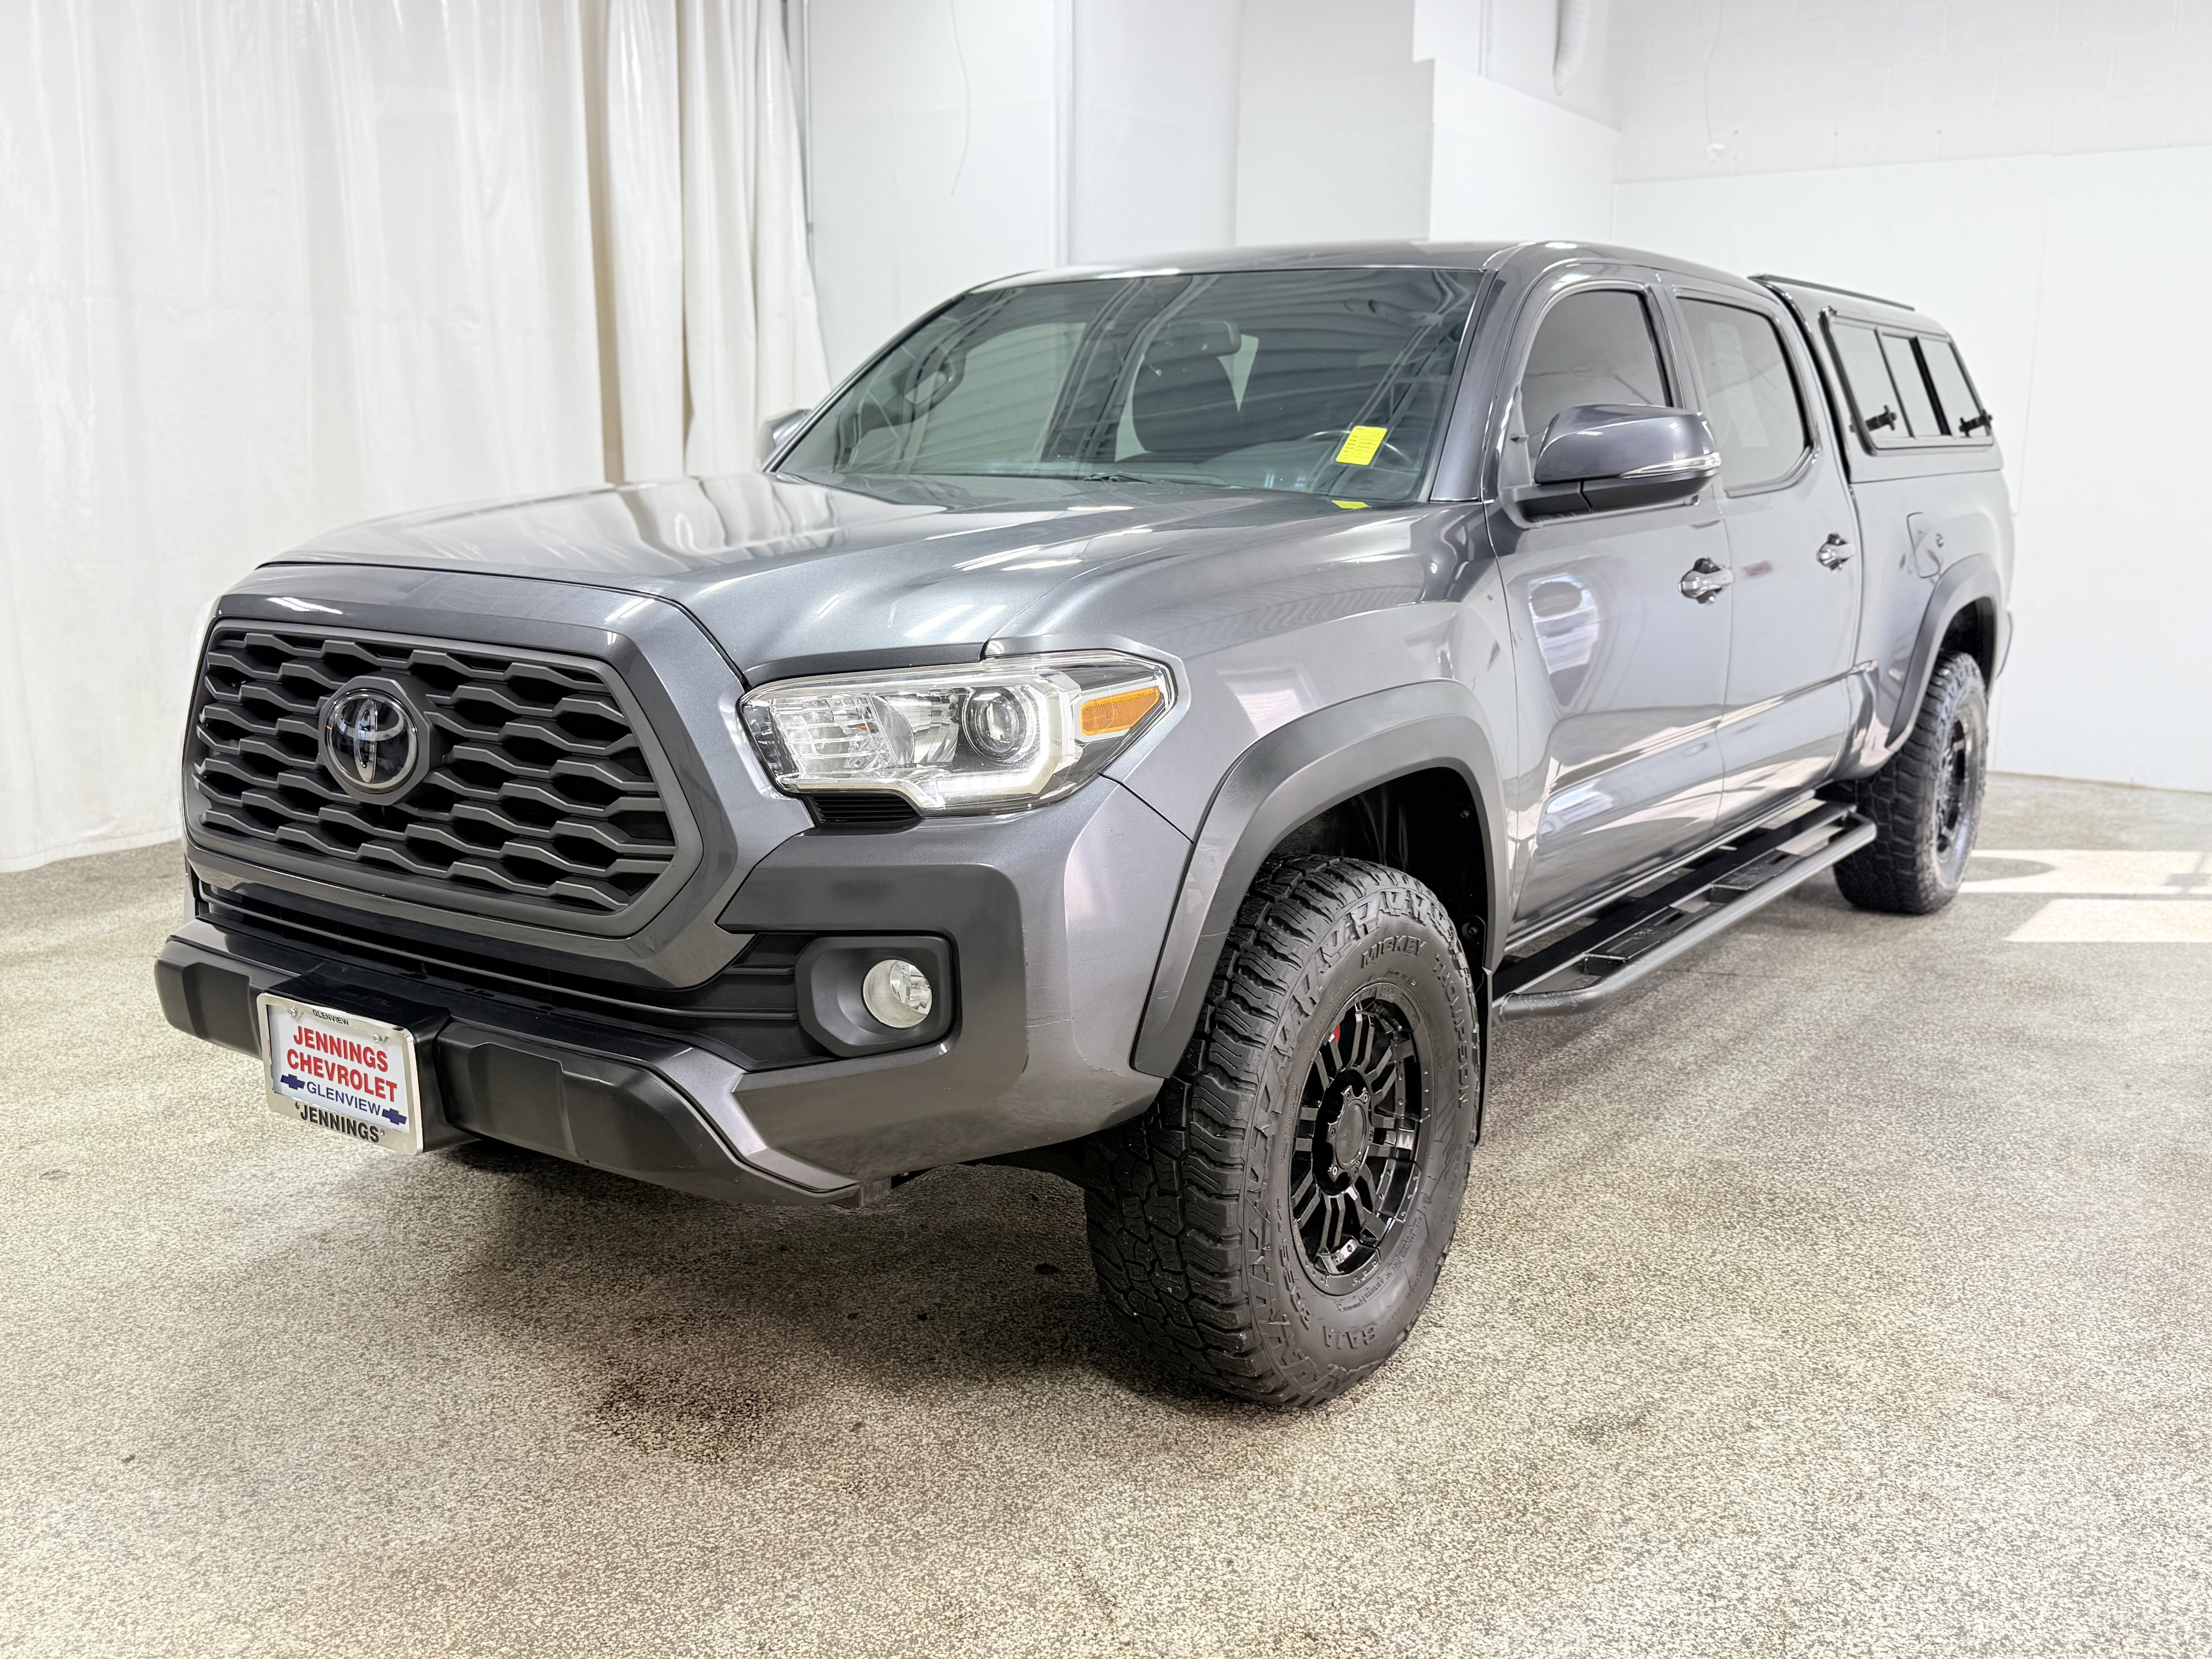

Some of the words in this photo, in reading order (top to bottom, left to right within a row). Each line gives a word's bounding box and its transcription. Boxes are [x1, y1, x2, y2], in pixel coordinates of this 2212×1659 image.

[312, 1009, 349, 1025] GLENVIEW
[293, 1025, 389, 1072] JENNINGS
[287, 1048, 398, 1103] CHEVROLET
[306, 1081, 381, 1116] GLENVIEW
[300, 1104, 380, 1143] JENNINGS
